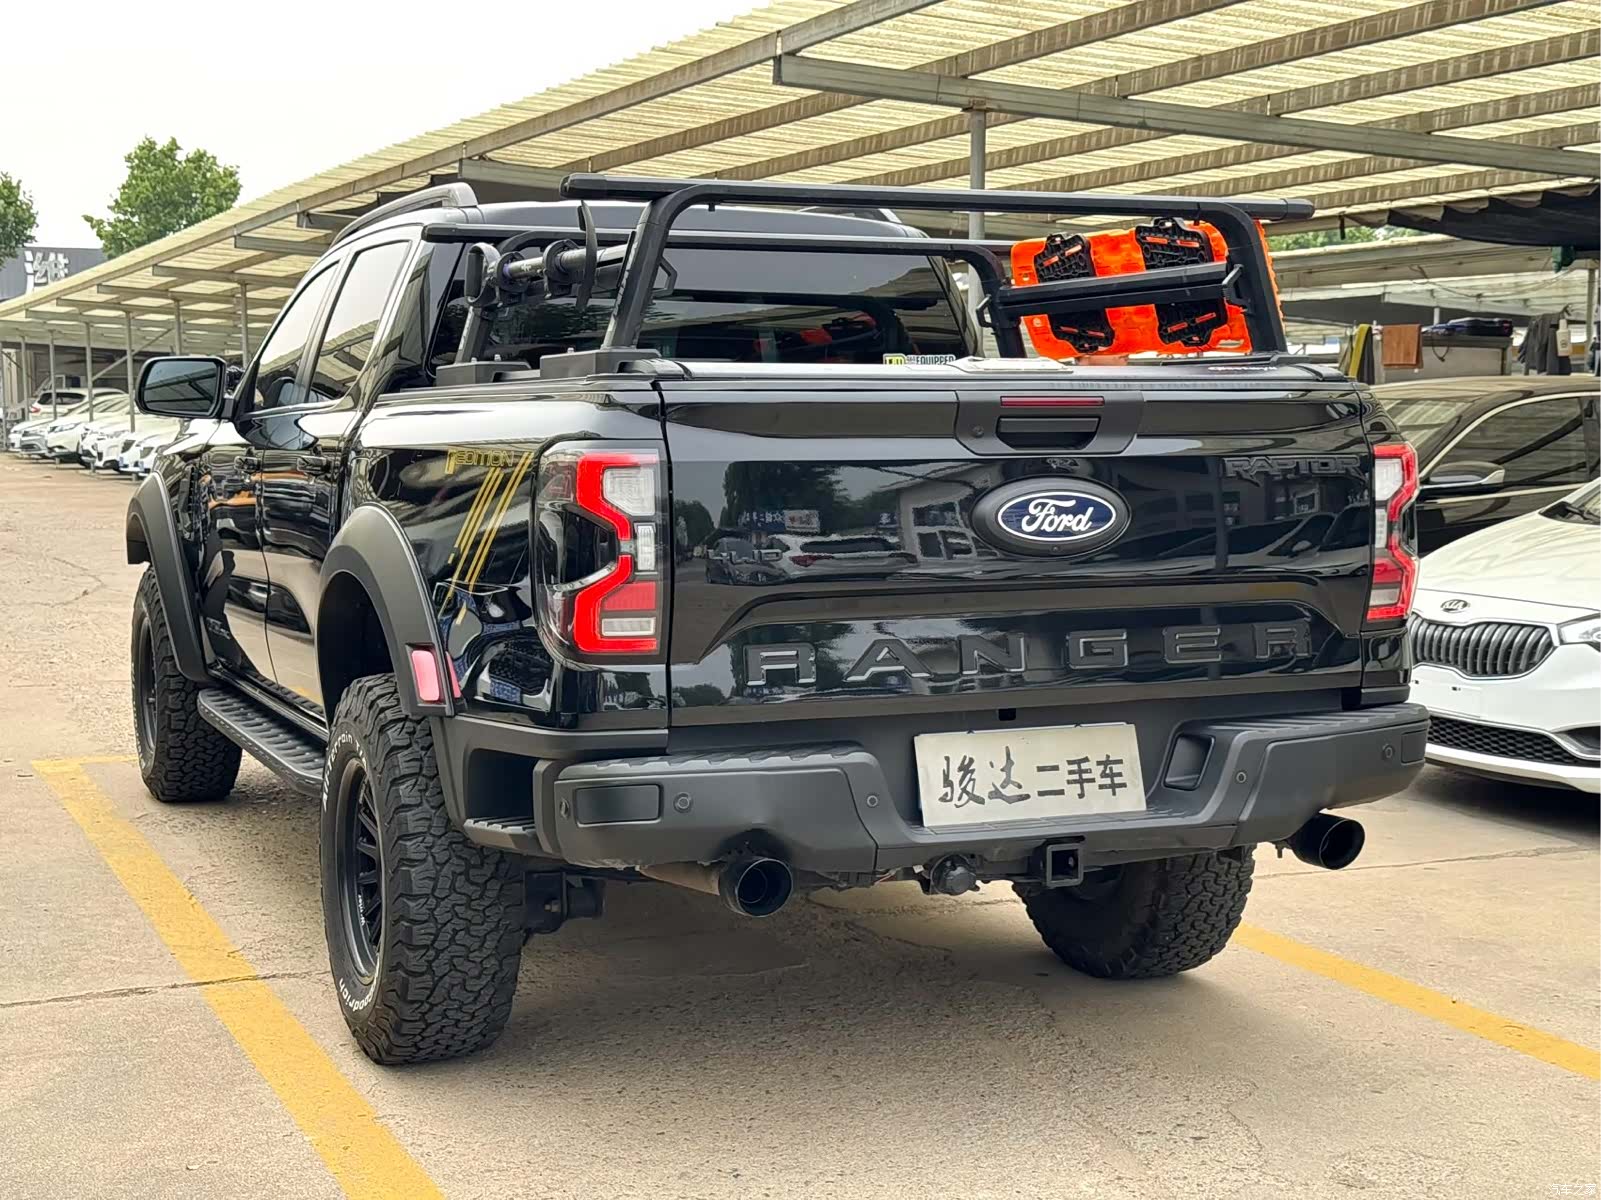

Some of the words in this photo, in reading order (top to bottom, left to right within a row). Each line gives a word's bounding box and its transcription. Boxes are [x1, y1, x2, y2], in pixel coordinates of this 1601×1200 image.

[1222, 454, 1366, 487] RAPTOR
[1021, 498, 1095, 532] Ford
[743, 619, 1313, 687] RANGER
[937, 746, 1128, 809] 骏达二手车
